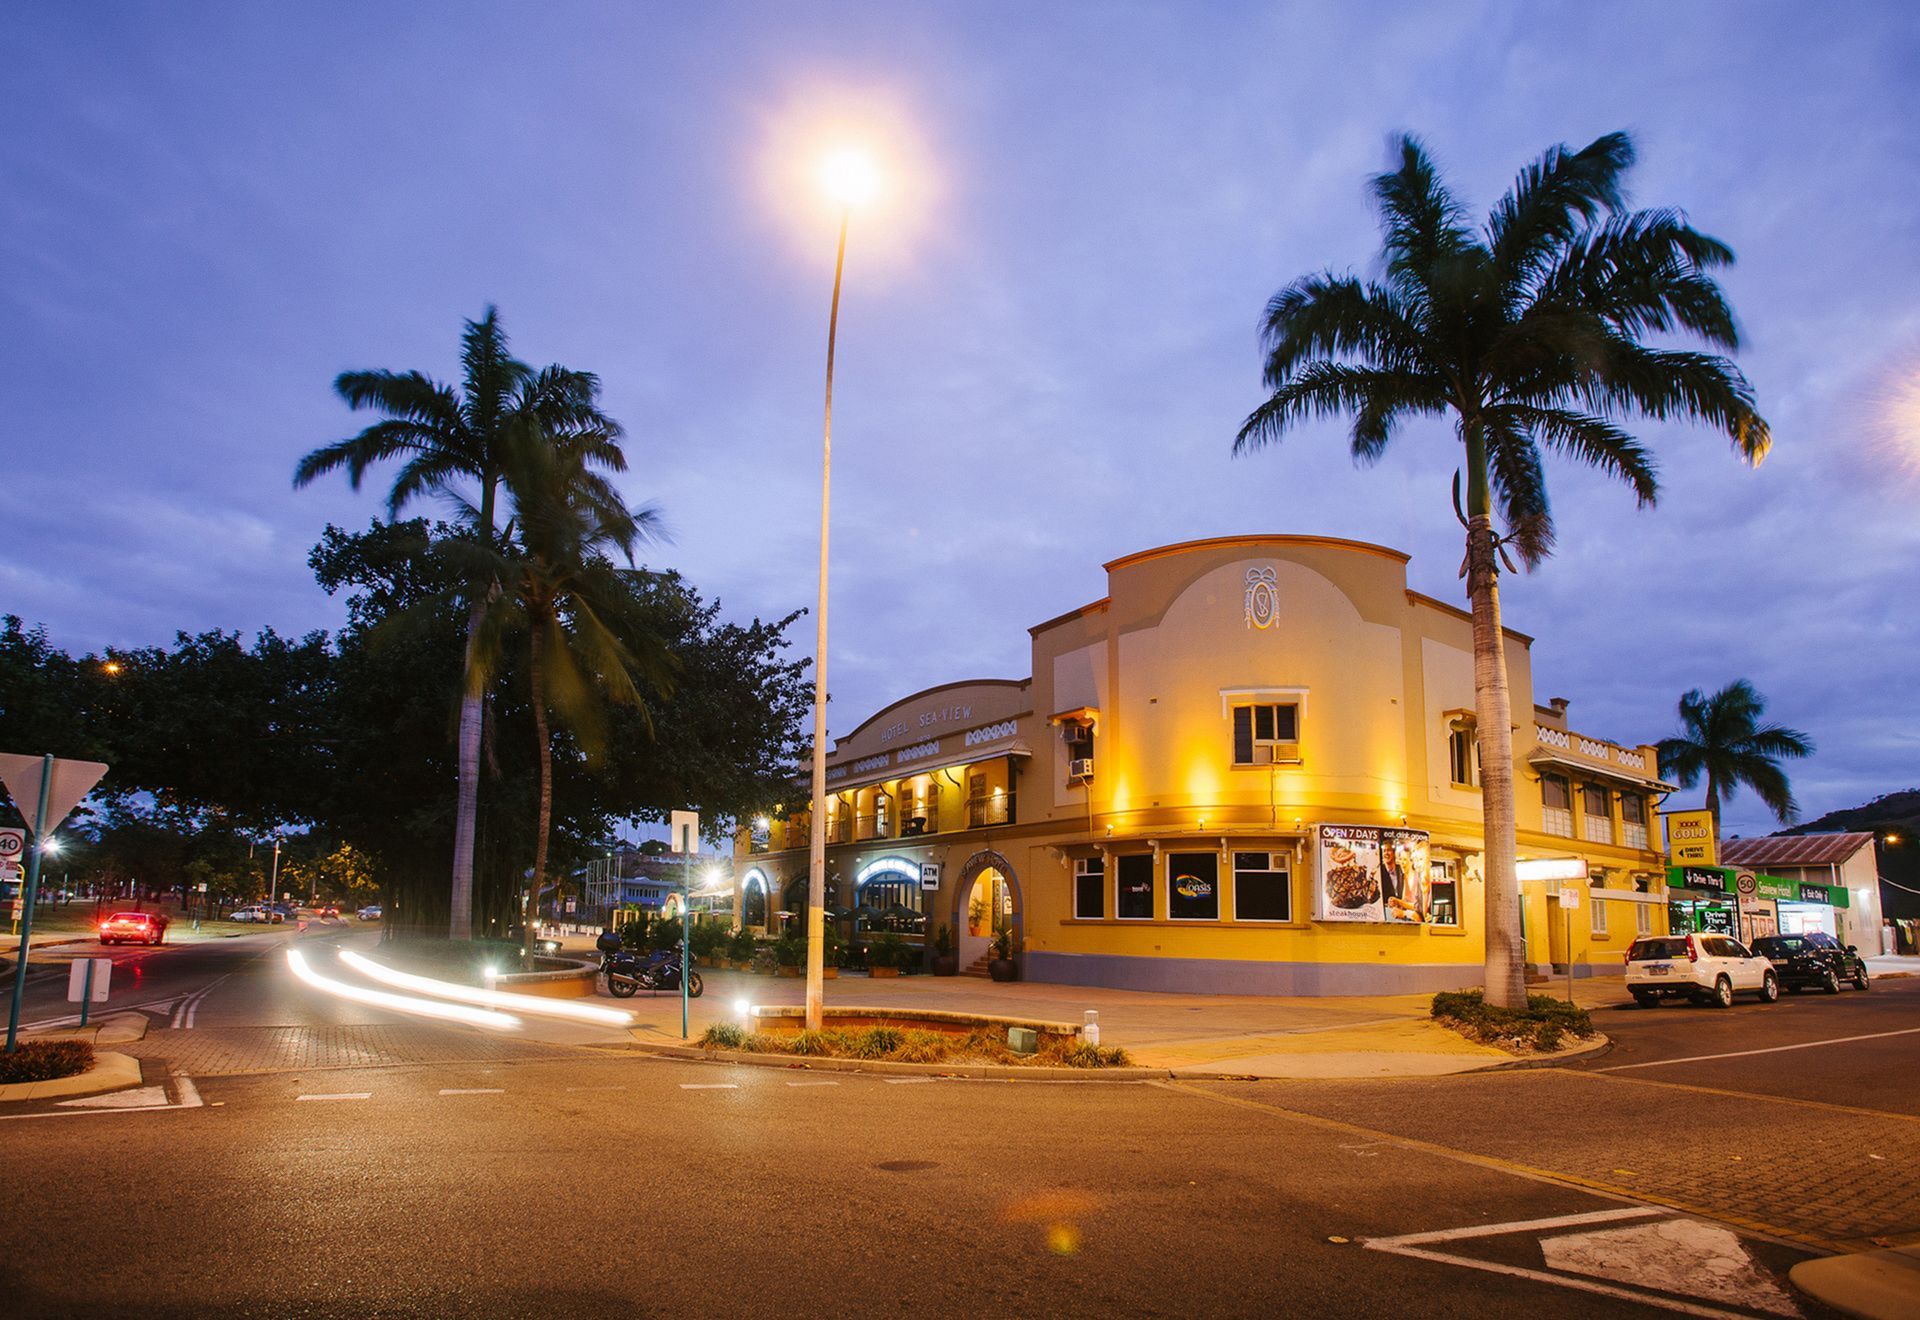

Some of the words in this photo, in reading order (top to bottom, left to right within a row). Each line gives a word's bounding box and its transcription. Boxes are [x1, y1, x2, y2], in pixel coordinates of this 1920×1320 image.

[881, 721, 909, 742] HOTEL
[1322, 827, 1347, 838] OPEN
[1349, 828, 1354, 838] 7
[1355, 829, 1378, 840] DAYS
[1673, 827, 1708, 839] GOLD
[0, 838, 18, 850] 40
[923, 867, 937, 876] ATM
[1693, 873, 1706, 884] Drive
[1740, 880, 1753, 889] 50
[1706, 917, 1726, 925] Thru
